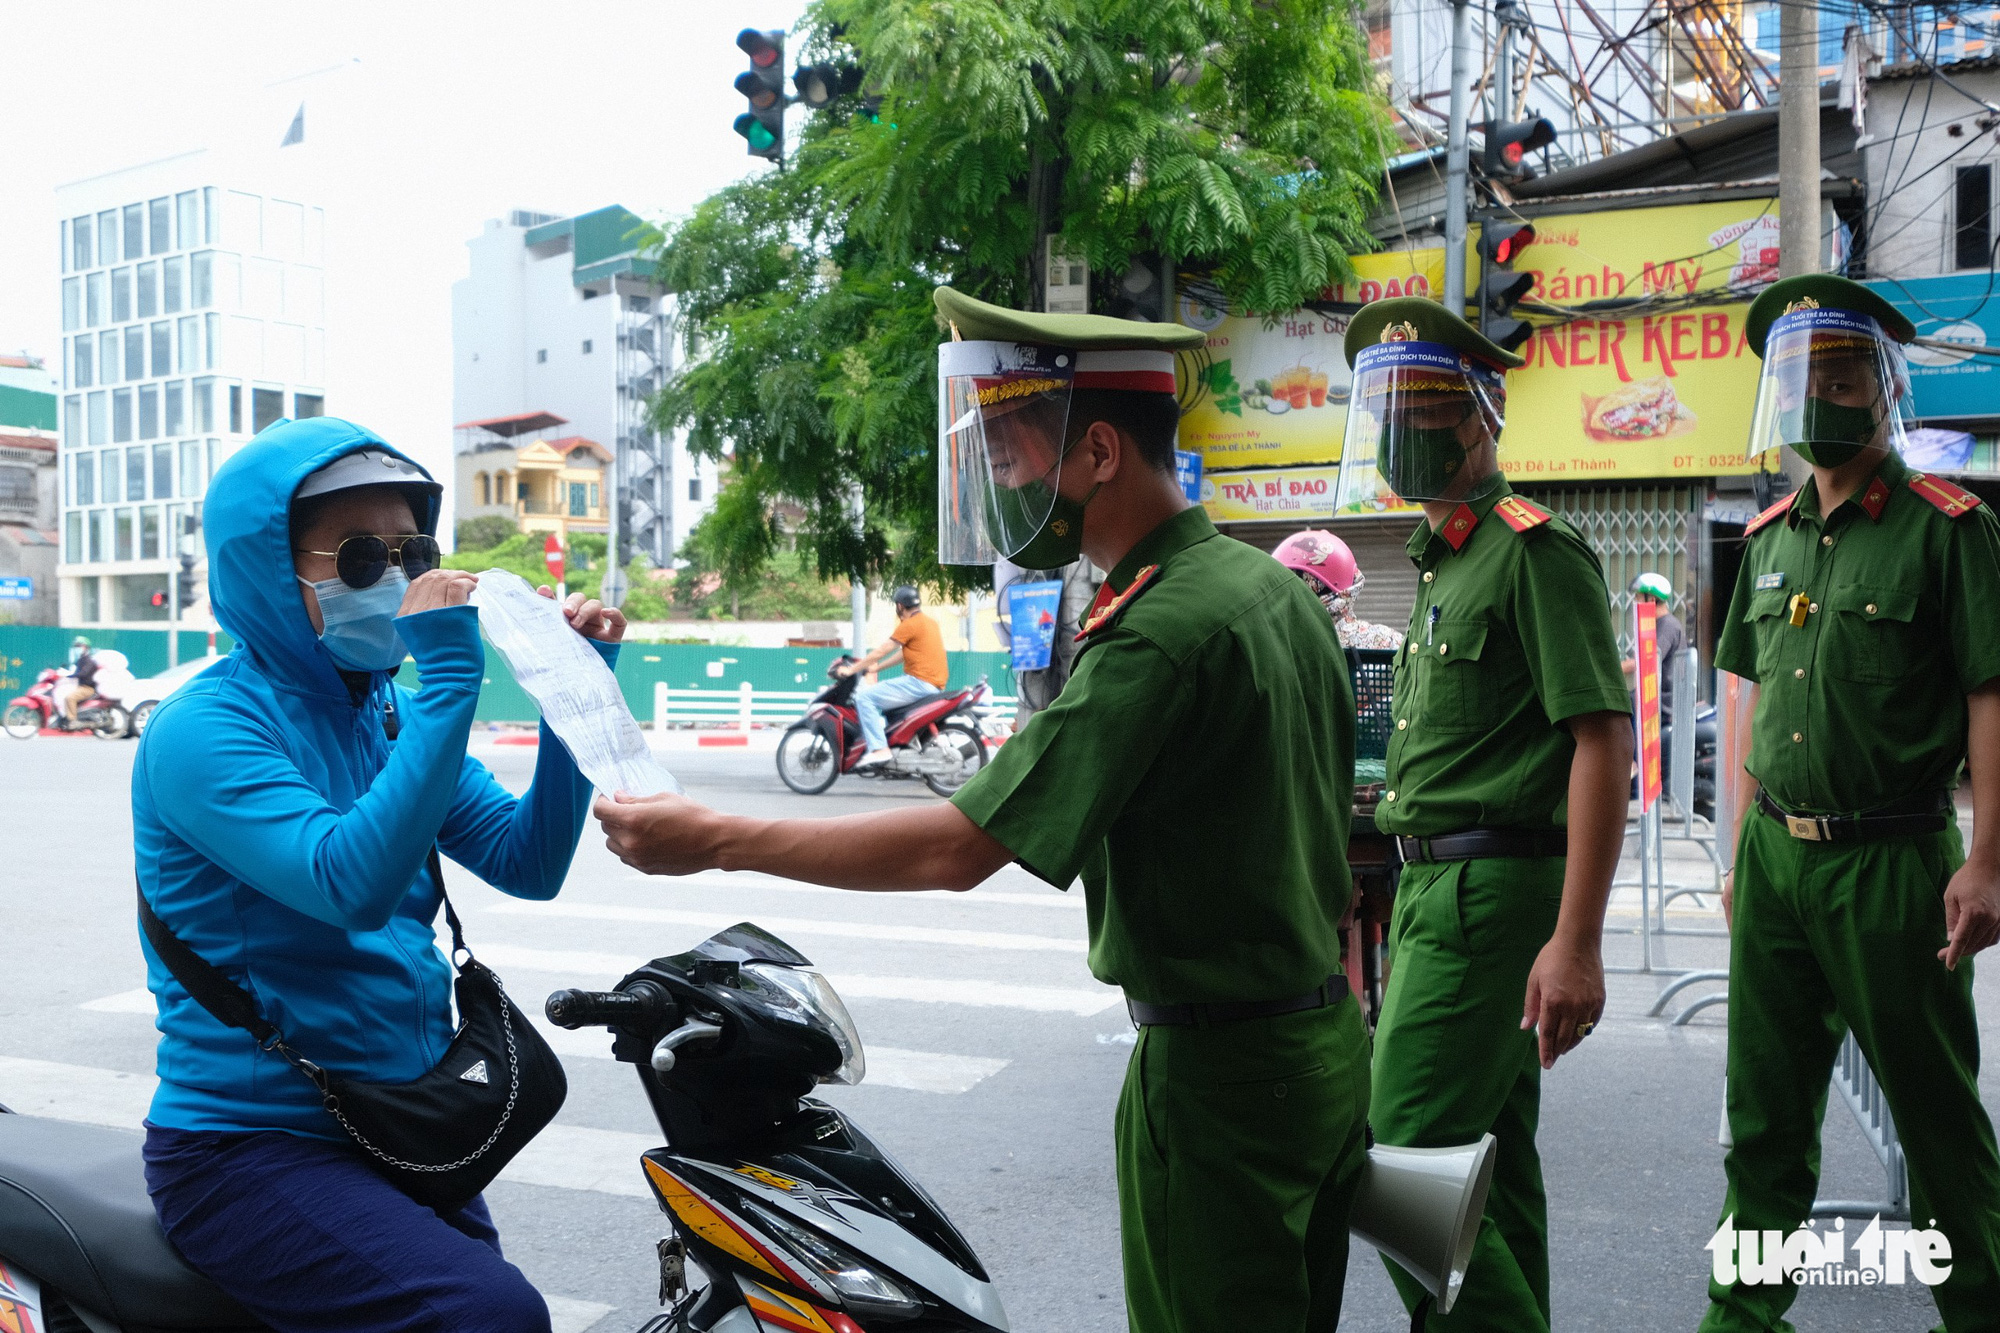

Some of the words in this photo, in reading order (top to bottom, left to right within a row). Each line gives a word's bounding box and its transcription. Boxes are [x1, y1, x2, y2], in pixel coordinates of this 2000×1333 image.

[1520, 264, 1625, 301] Bánh
[1285, 320, 1315, 340] Hạt
[1241, 442, 1252, 451] LA
[1549, 460, 1567, 472] La
[1571, 457, 1617, 471] Thành
[1709, 454, 1744, 468] 0325
[1222, 477, 1258, 503] TRÀ
[1265, 477, 1282, 497] BÍ
[1289, 479, 1328, 496] ĐAO
[1255, 499, 1274, 514] Hạt
[1278, 498, 1301, 511] Chia
